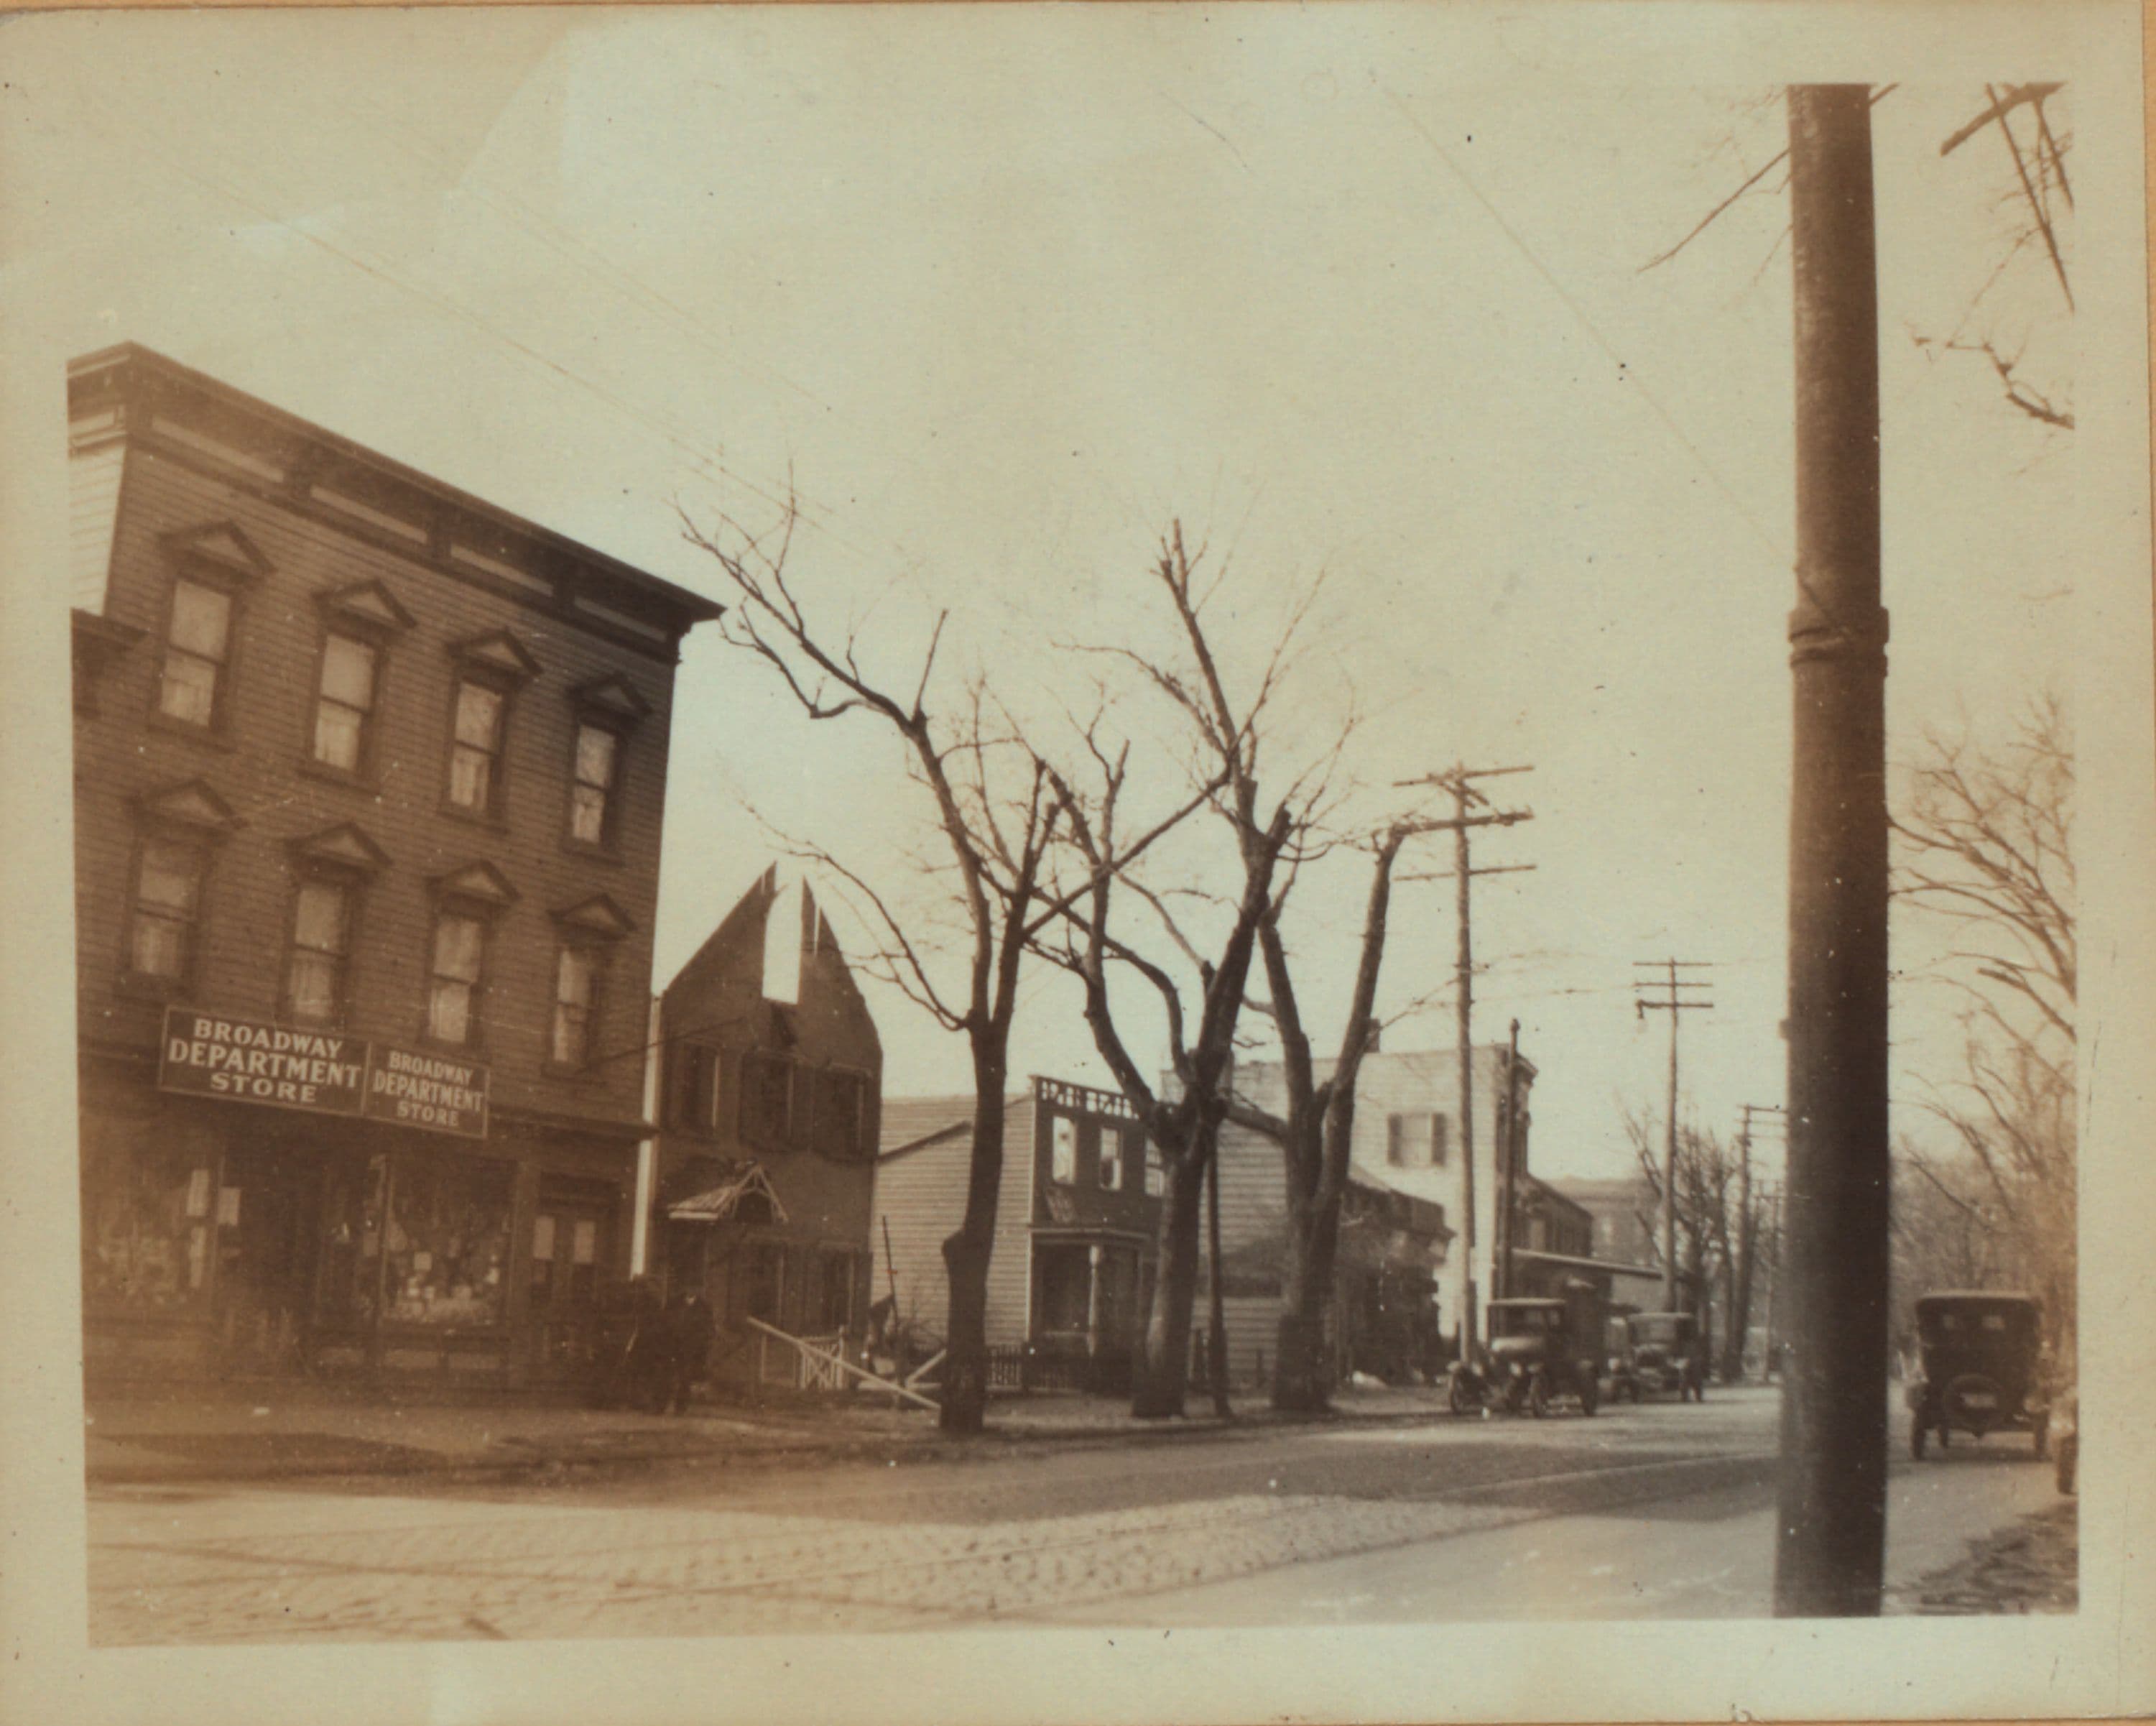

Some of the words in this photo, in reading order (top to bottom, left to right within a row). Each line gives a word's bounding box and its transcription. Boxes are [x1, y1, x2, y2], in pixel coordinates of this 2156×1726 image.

[194, 1017, 343, 1059] BROADWAY
[168, 1038, 362, 1089] DEPARTMENT
[389, 1050, 473, 1085] BROADWAY
[210, 1071, 318, 1103] STORE
[372, 1069, 485, 1113] DEPARTMENT
[396, 1100, 460, 1127] STORE
